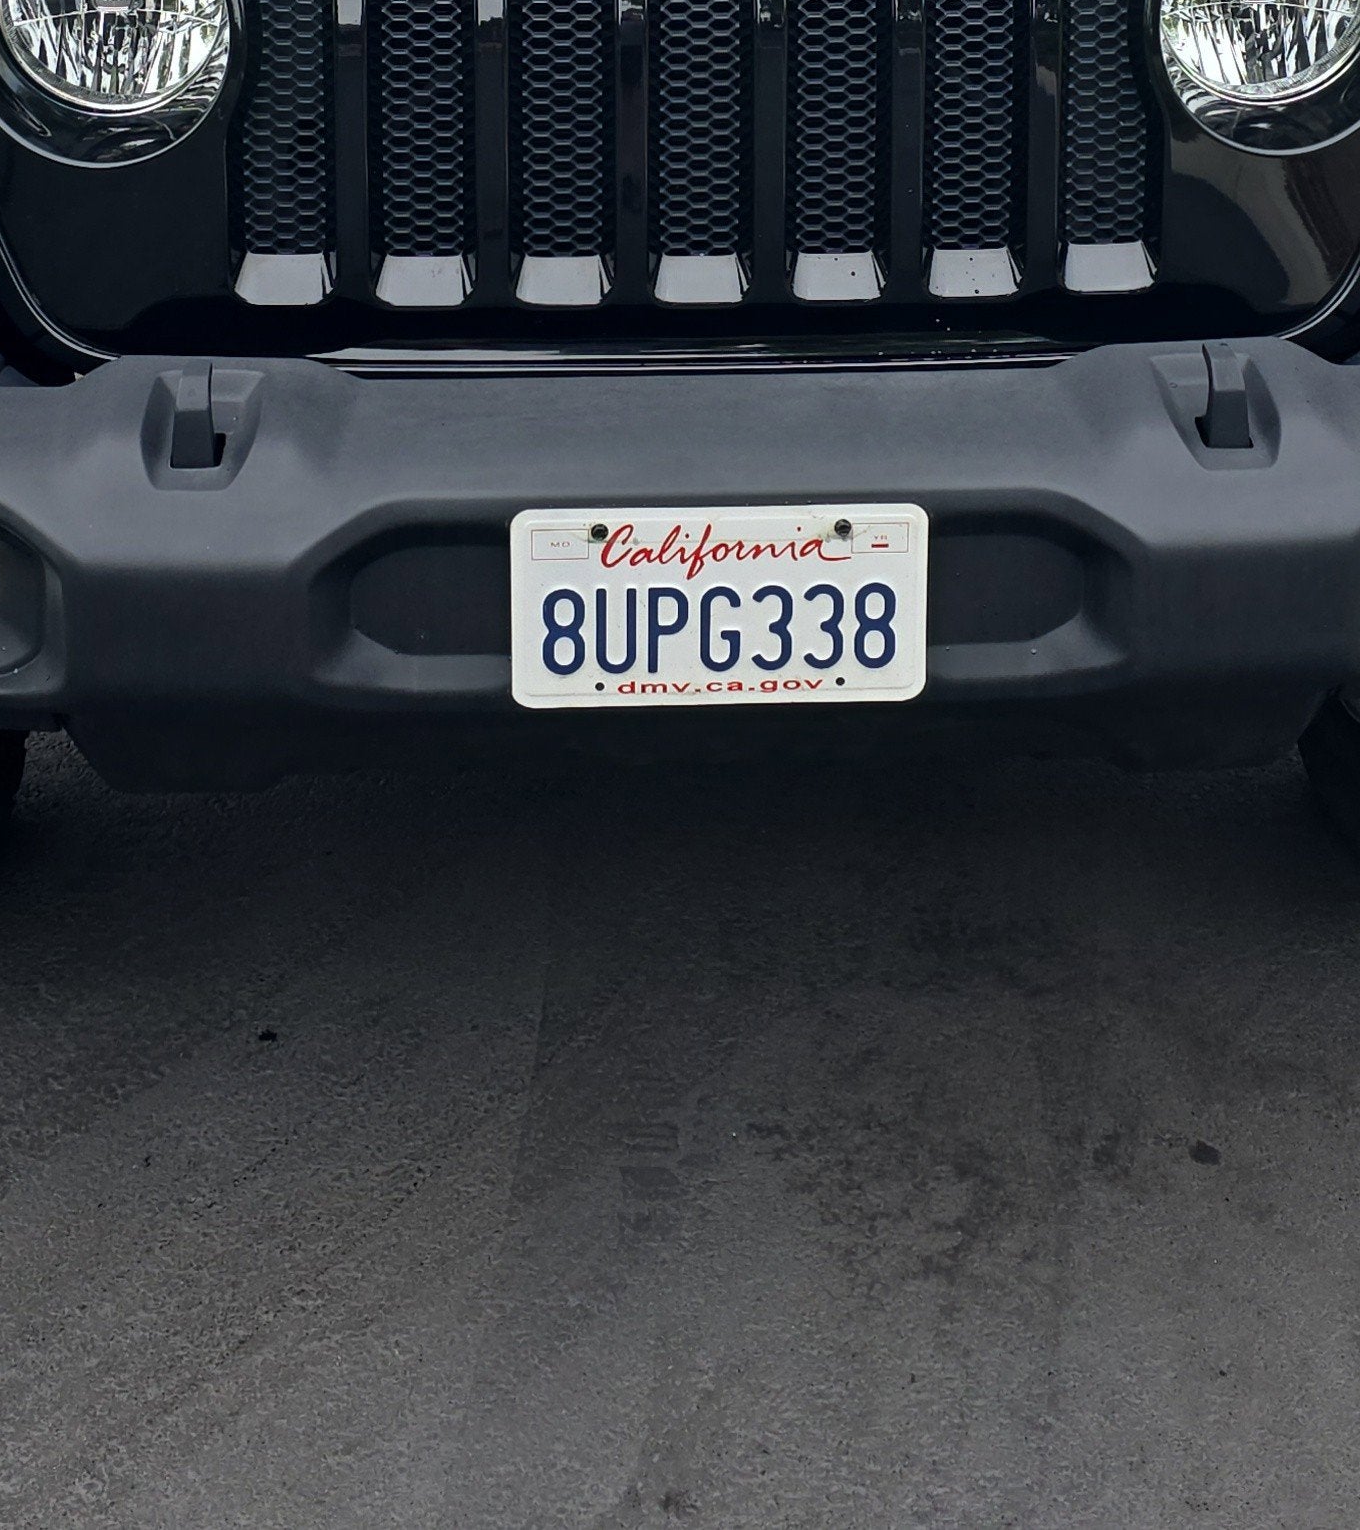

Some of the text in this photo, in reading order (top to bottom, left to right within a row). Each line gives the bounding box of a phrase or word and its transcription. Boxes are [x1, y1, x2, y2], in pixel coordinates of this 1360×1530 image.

[601, 523, 851, 580] California
[542, 582, 896, 675] 8UPG338
[617, 678, 823, 695] dmv.ca.gov
